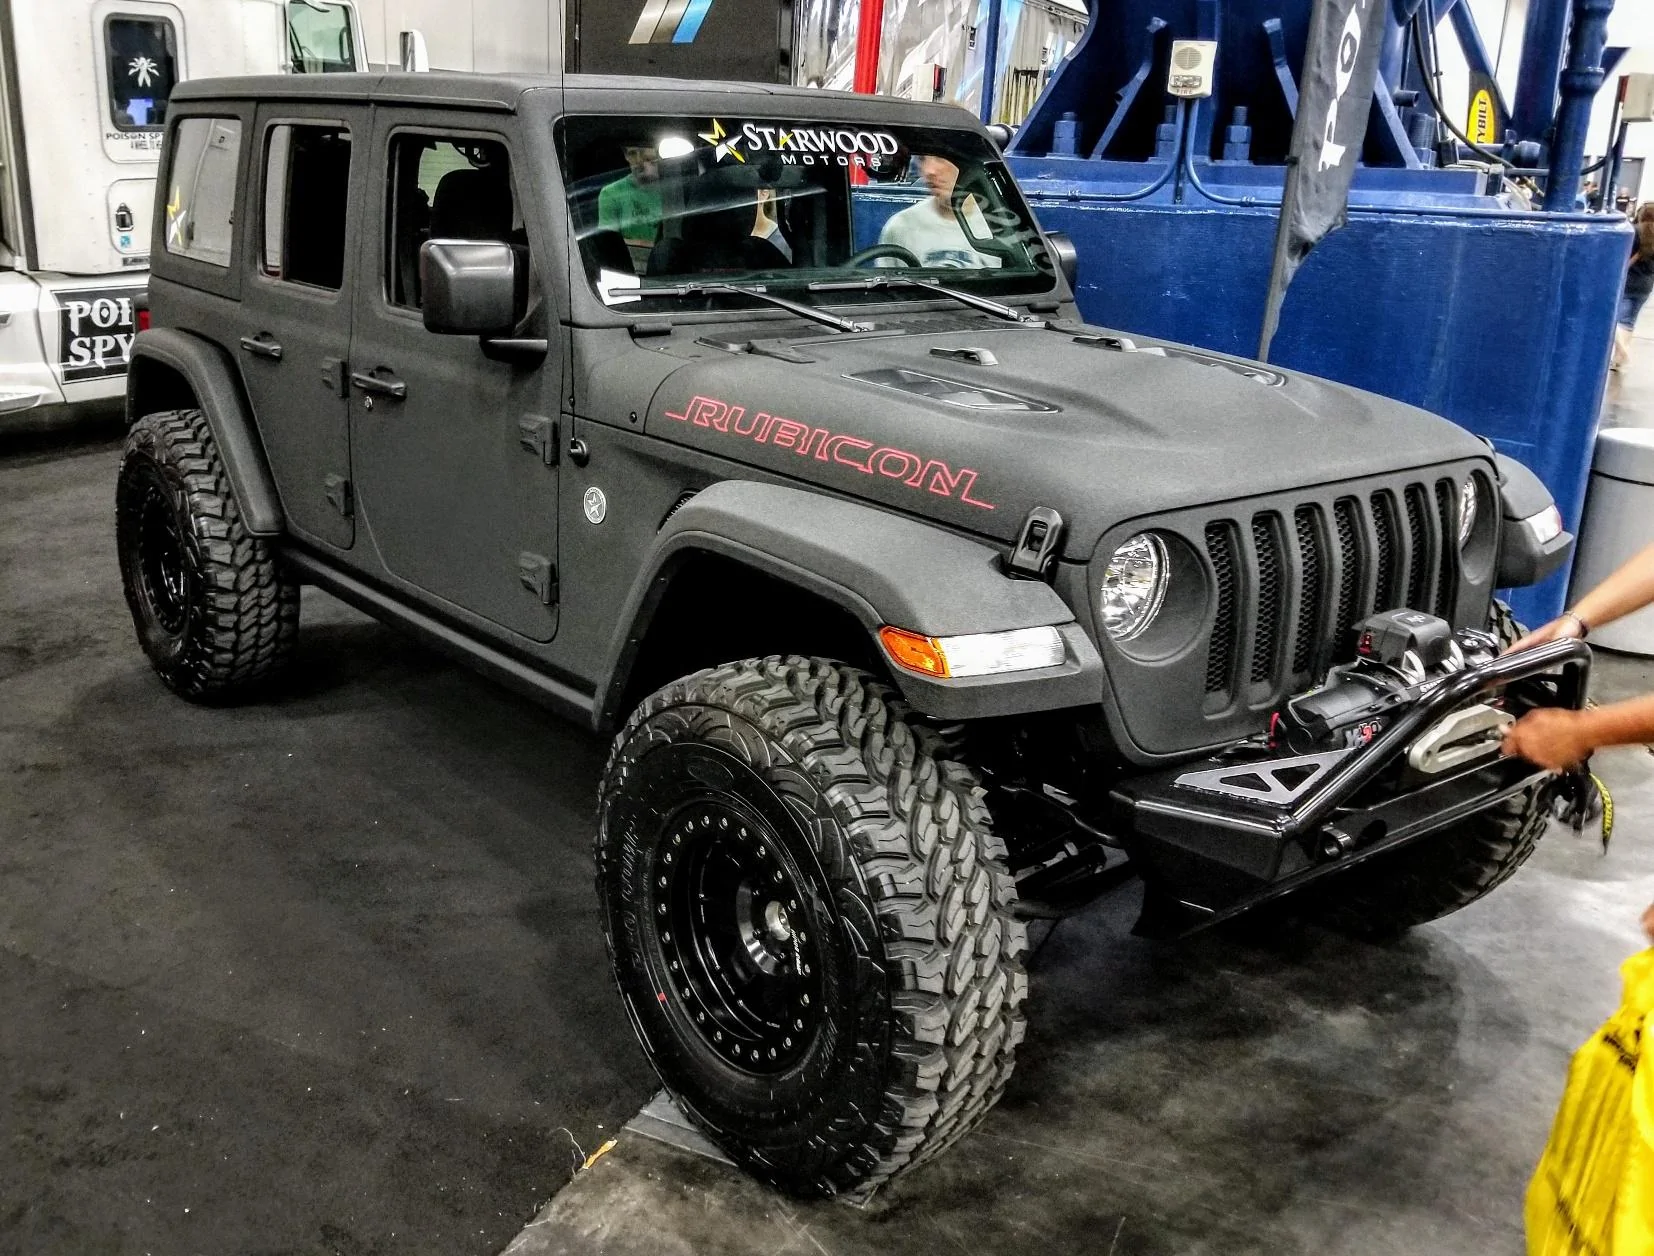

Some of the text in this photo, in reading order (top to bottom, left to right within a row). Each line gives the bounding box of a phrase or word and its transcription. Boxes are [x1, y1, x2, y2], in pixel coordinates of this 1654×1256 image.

[1318, 0, 1366, 172] PO
[106, 132, 164, 140] POISON SP
[742, 123, 898, 155] STARWOOD
[780, 154, 882, 167] MOTORS
[68, 333, 136, 369] SPY
[664, 396, 995, 510] RUBICON
